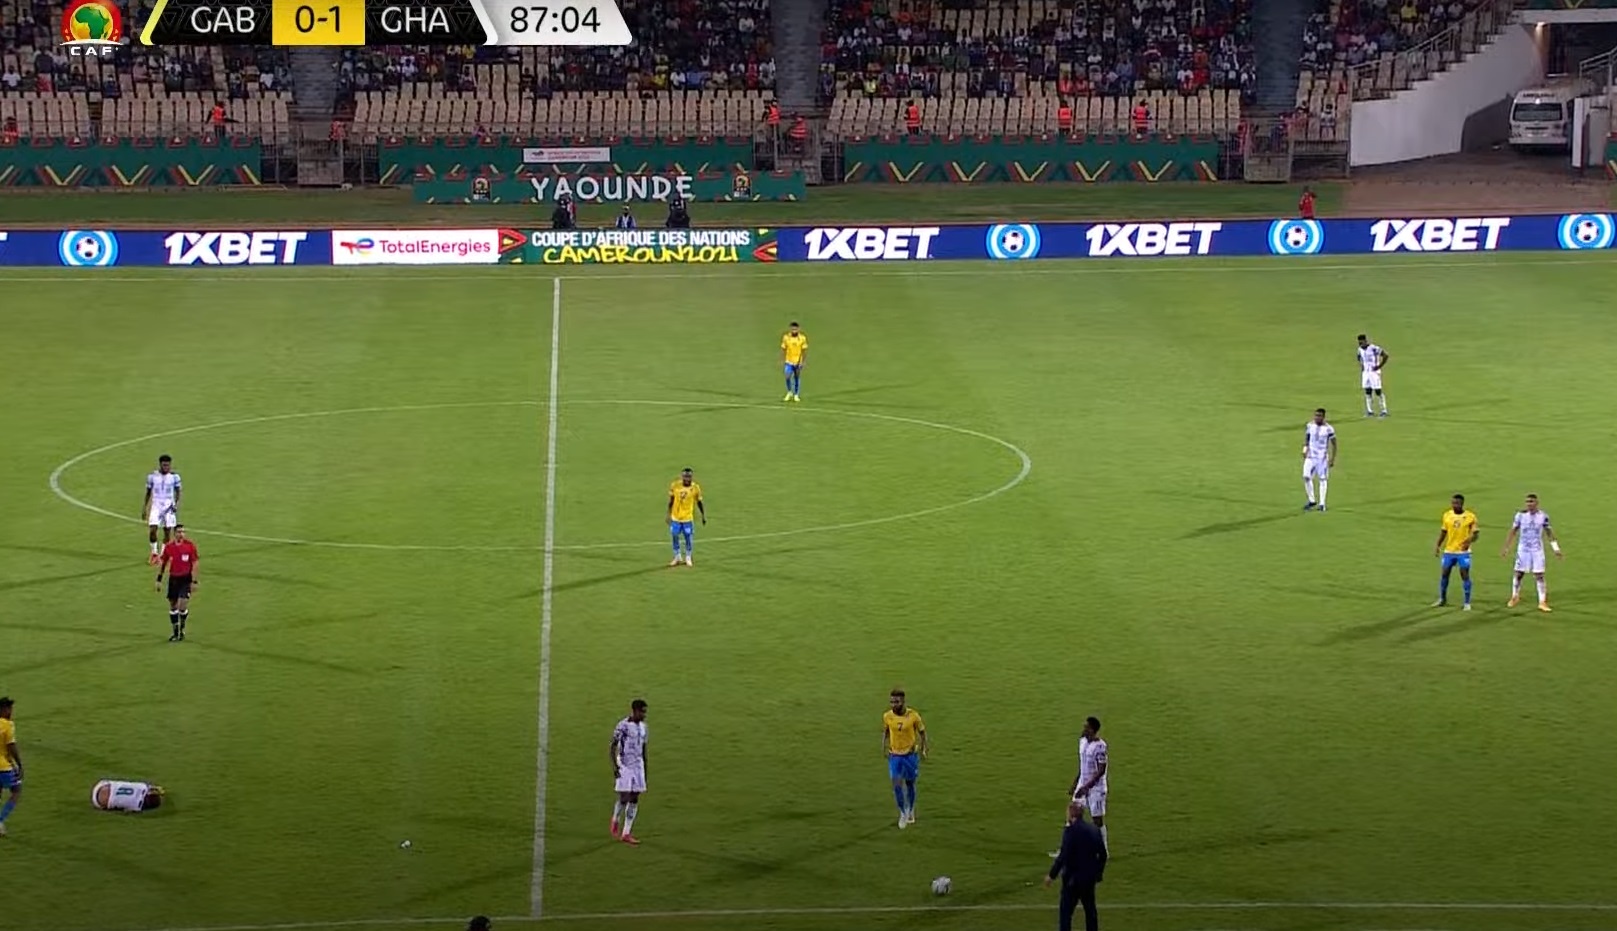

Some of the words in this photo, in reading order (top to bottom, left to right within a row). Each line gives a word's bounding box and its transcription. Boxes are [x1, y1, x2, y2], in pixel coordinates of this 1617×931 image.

[531, 175, 693, 201] YAOUNDE
[165, 232, 308, 264] 1XBET
[379, 239, 491, 255] TotalEnergies
[532, 232, 579, 246] COUPE
[583, 231, 655, 248] D'AFRIQUE
[660, 231, 685, 247] DES
[690, 231, 750, 246] NATIONS
[804, 227, 939, 259] 1XBET
[1086, 222, 1222, 256] 1XBET
[1370, 218, 1508, 251] 1XBET
[897, 722, 903, 732] 7
